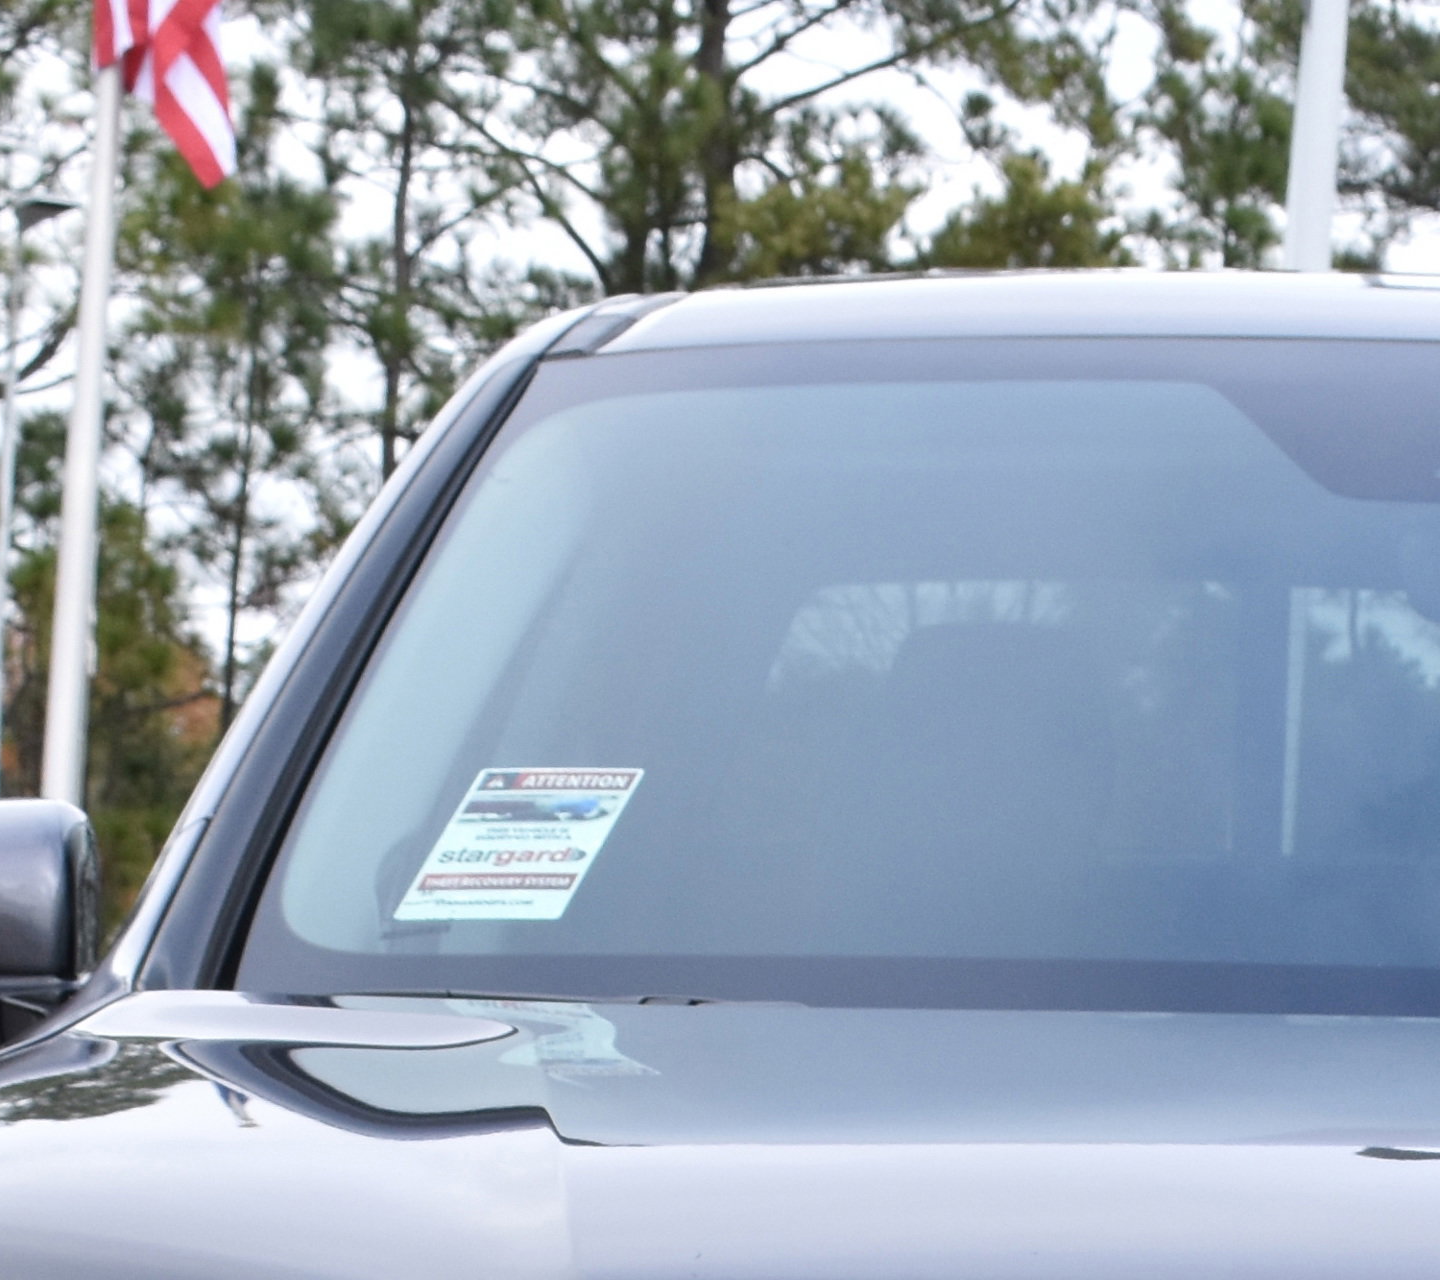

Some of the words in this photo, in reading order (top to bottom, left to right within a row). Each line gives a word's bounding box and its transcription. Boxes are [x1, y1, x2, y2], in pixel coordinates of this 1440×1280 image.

[521, 774, 631, 789] ATTENTION
[438, 846, 572, 867] stargard
[462, 876, 523, 888] RECOVERY
[525, 876, 571, 888] SYSTEM
